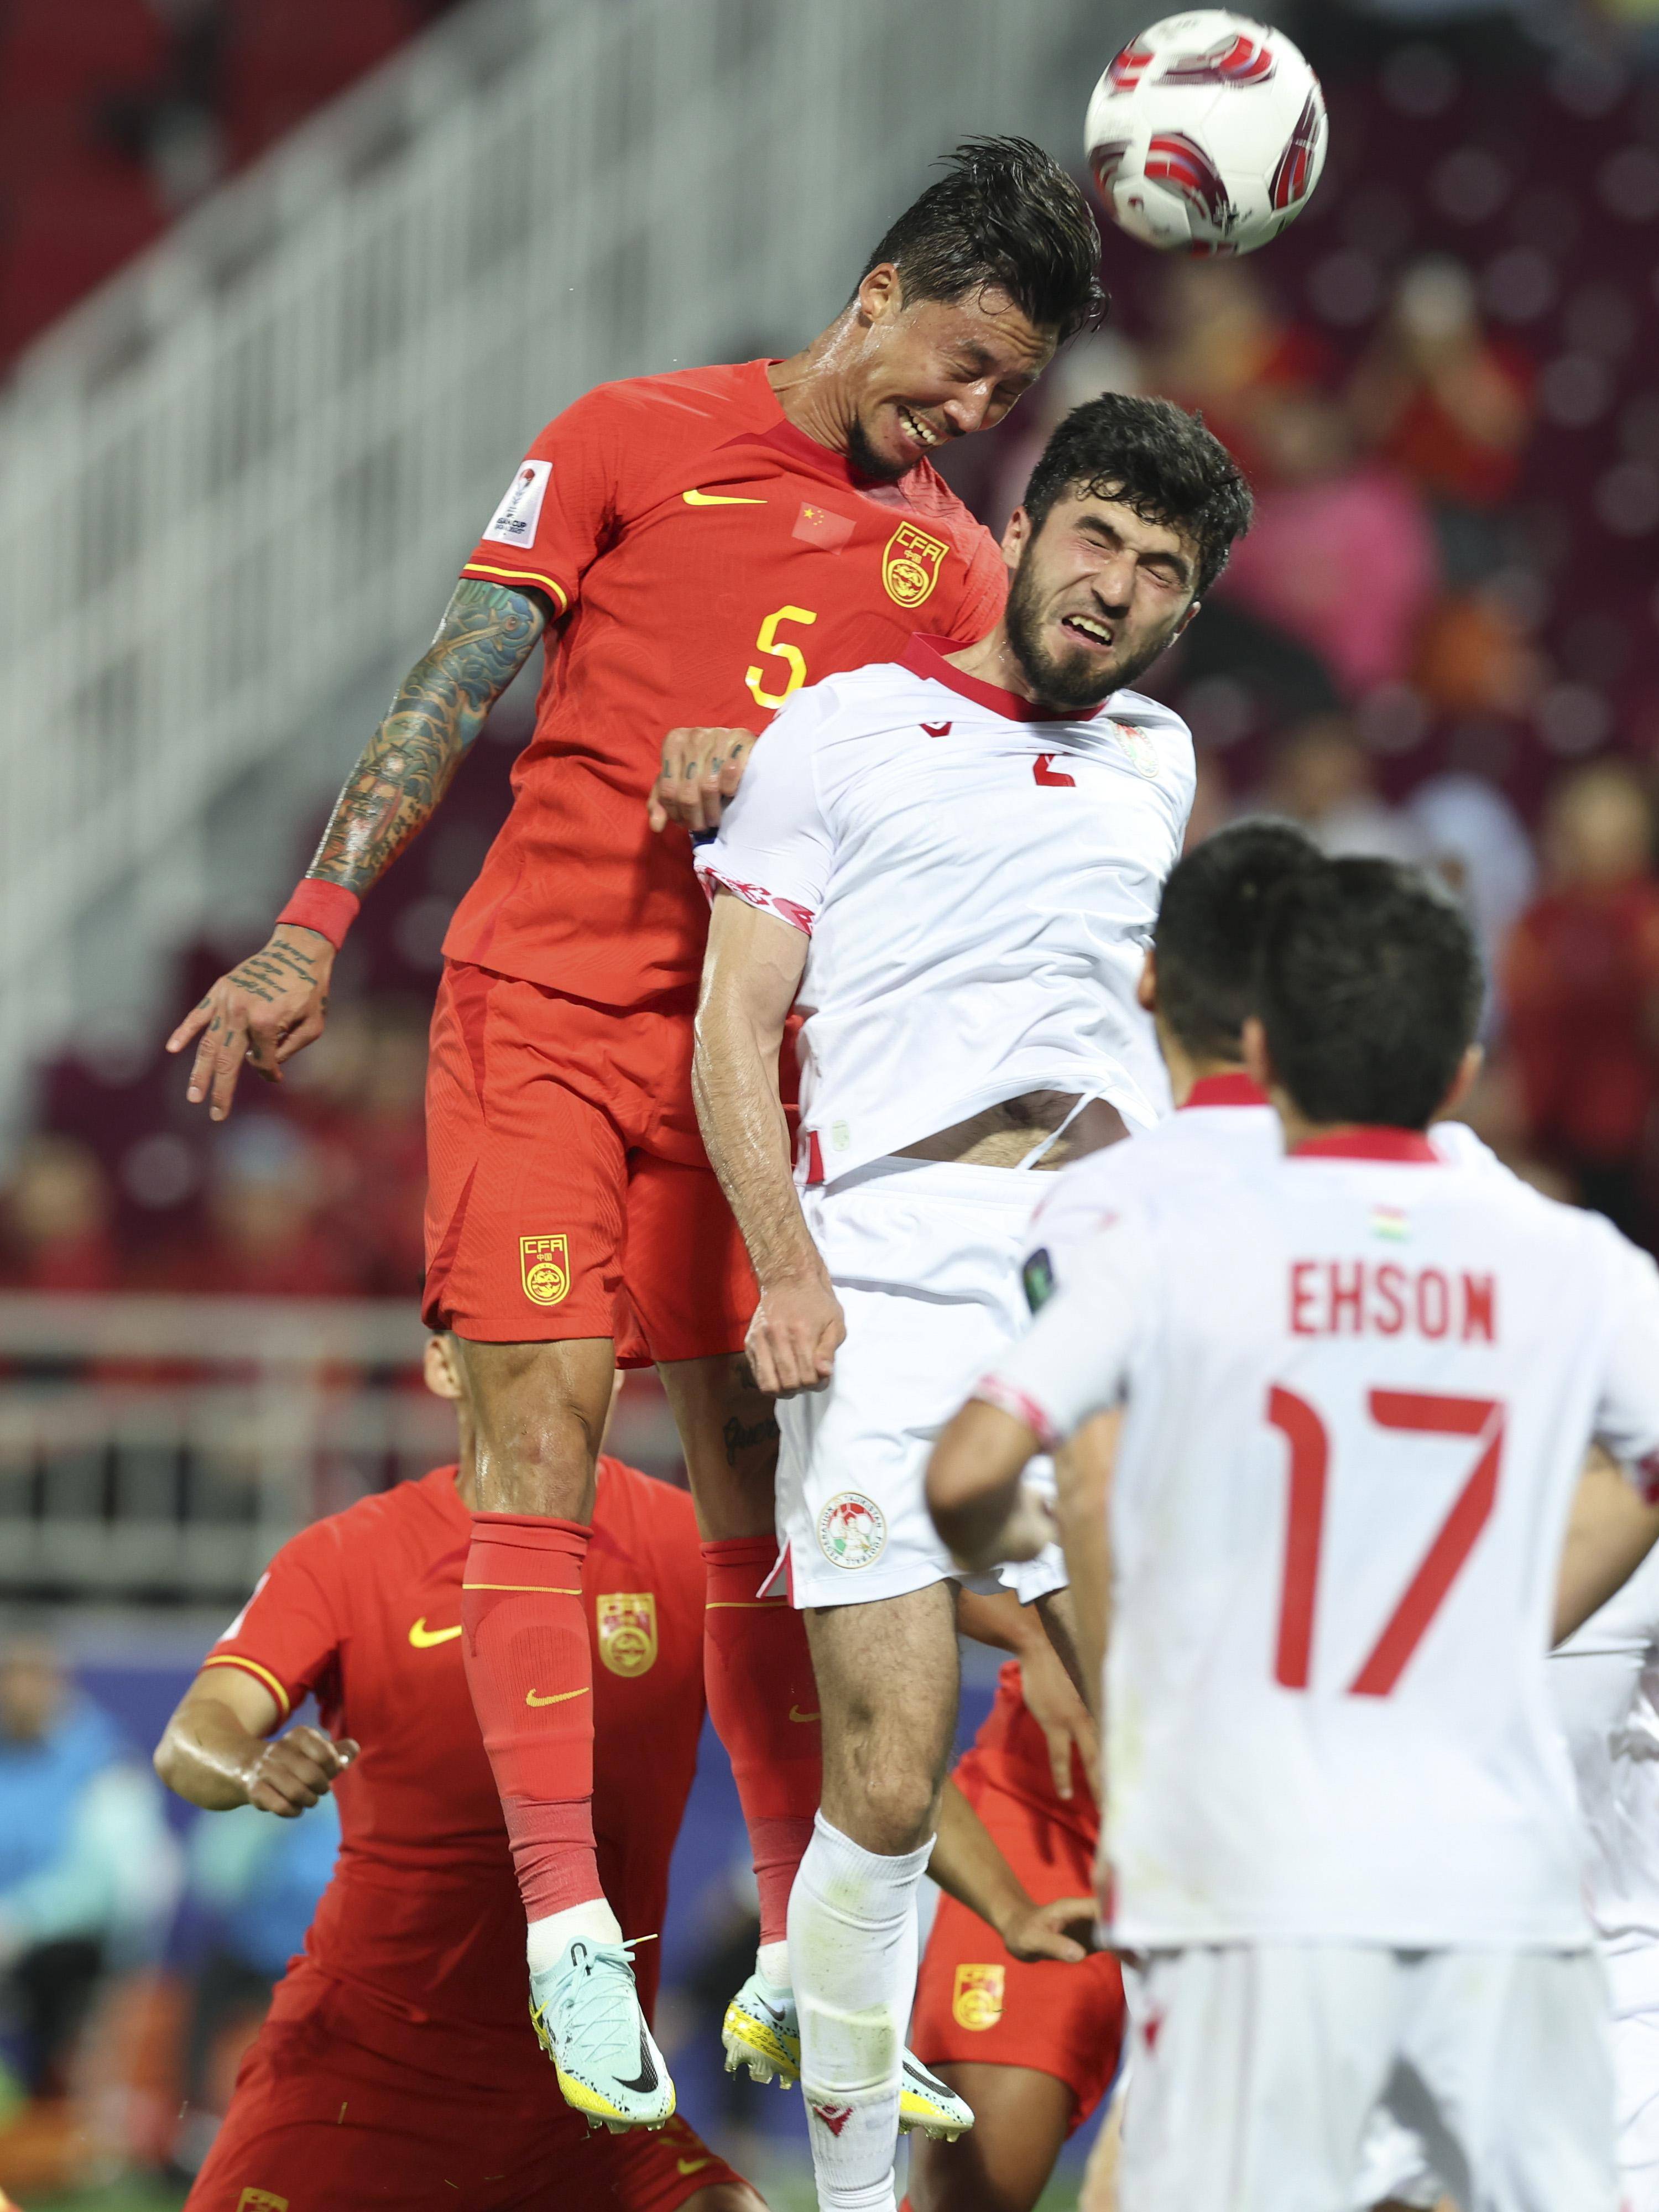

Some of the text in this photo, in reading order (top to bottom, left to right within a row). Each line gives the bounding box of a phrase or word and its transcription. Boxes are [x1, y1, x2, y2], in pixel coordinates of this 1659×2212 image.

[896, 529, 942, 562] CFA
[745, 605, 817, 709] 5
[524, 1239, 563, 1254] CFA
[1291, 1259, 1495, 1344] EHSON
[1265, 1383, 1505, 1700] 17
